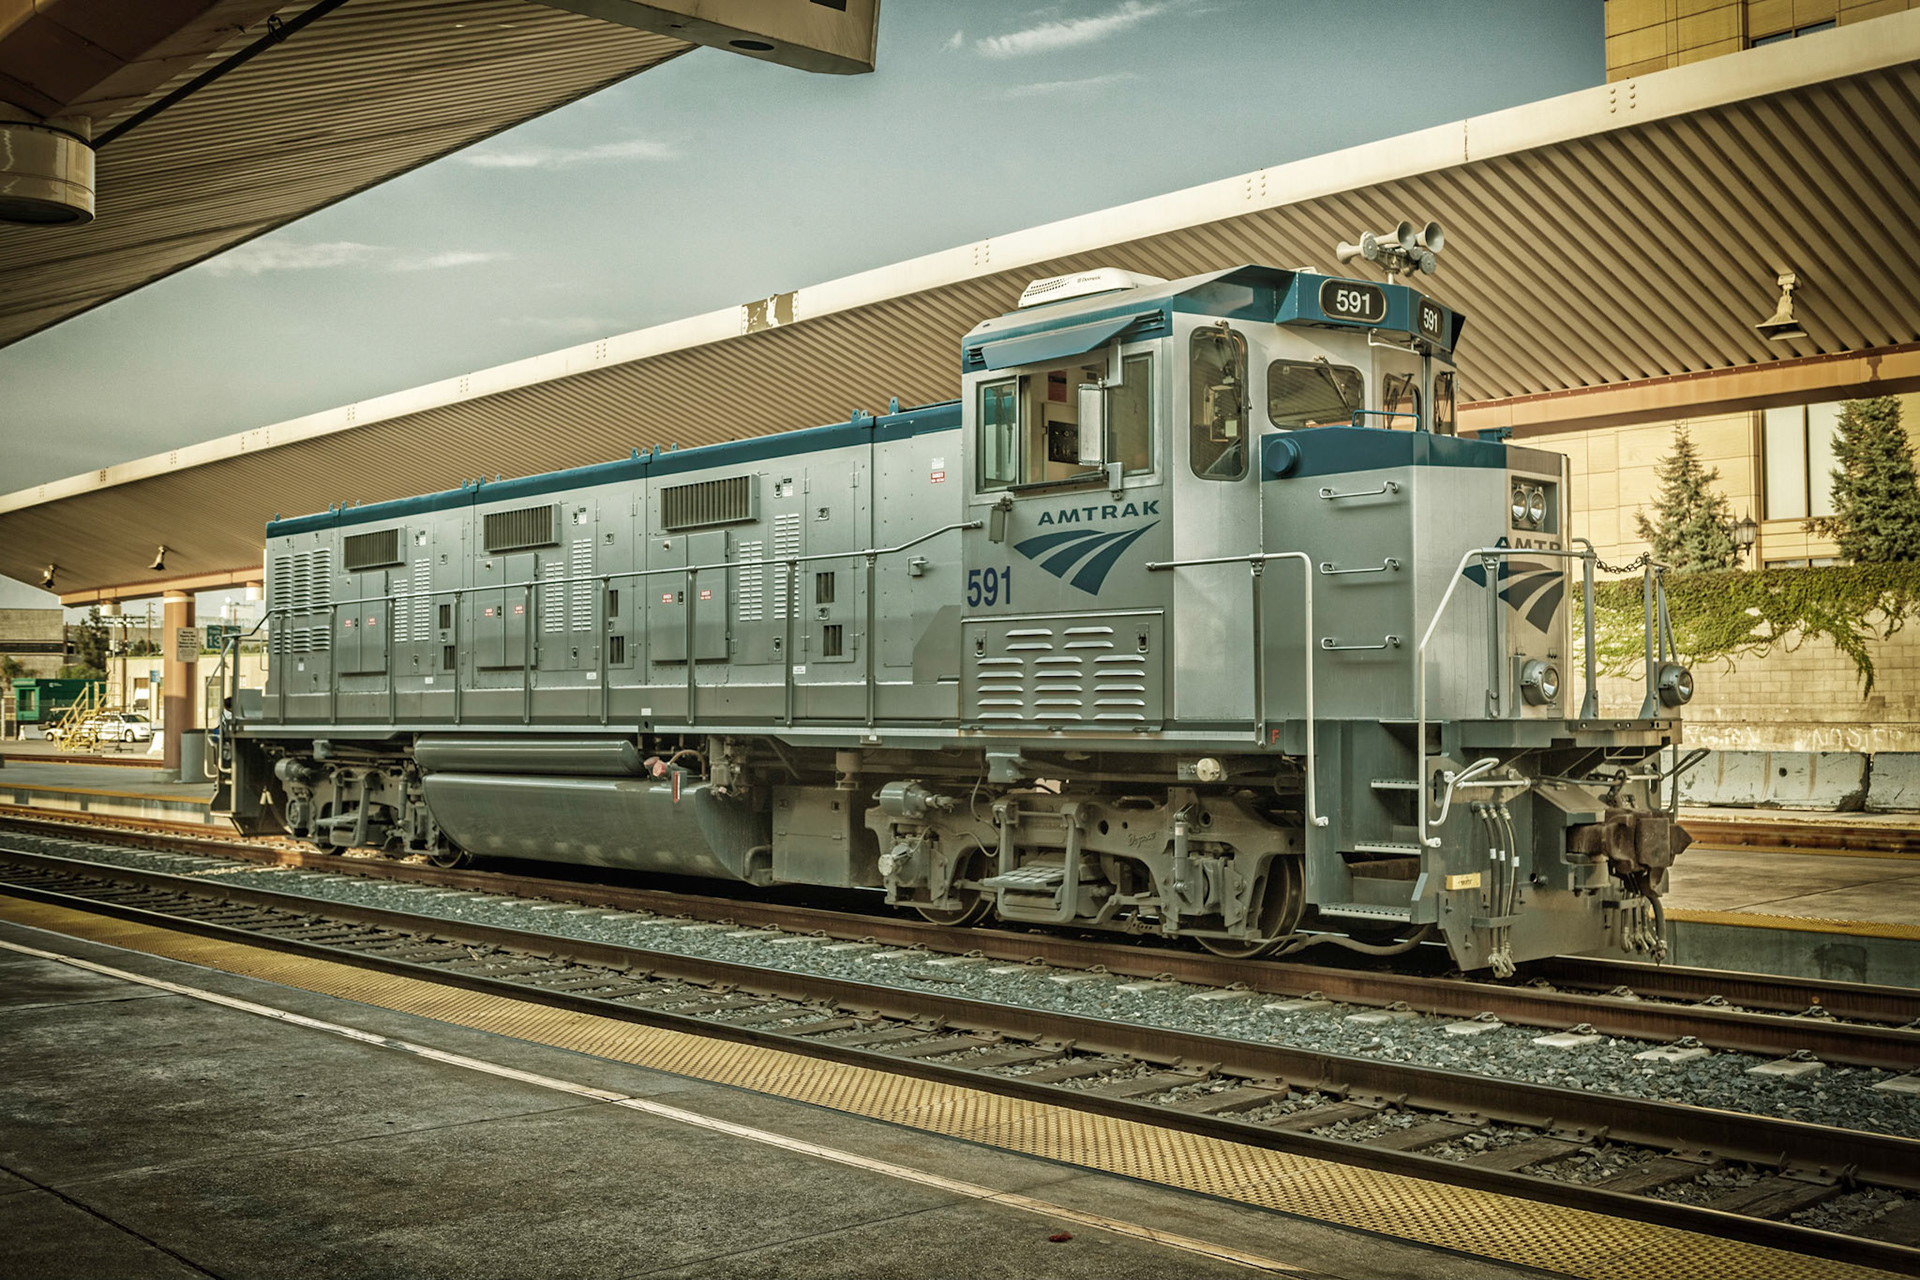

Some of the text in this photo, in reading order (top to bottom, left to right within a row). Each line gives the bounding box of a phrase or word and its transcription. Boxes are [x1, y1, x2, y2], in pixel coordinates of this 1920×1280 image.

[1336, 289, 1370, 315] 591
[1423, 307, 1438, 333] 591
[1037, 499, 1160, 527] AMTRAK
[966, 565, 1011, 608] 591
[208, 634, 222, 647] 13
[1271, 729, 1280, 744] F
